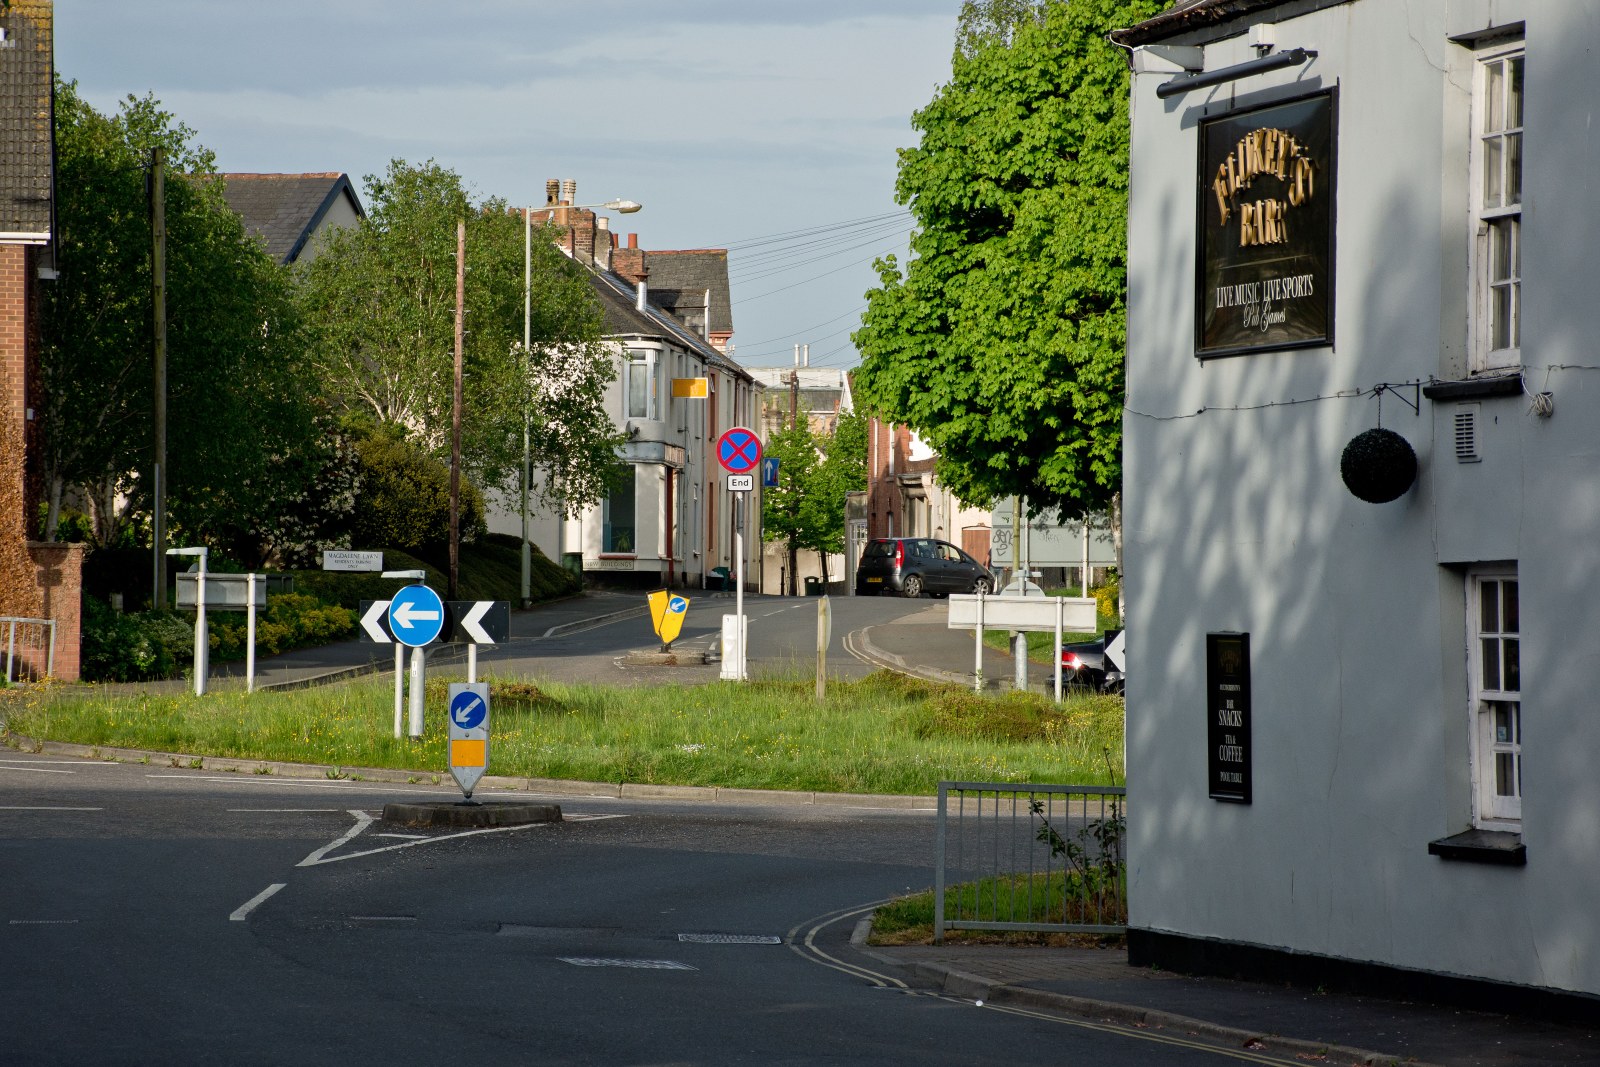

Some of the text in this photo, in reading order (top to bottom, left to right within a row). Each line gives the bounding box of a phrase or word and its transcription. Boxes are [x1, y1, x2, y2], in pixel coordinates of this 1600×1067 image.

[1239, 199, 1281, 247] BAR
[1216, 274, 1314, 308] LIVE MUSIC LIVE SPORTS
[1243, 297, 1286, 332] Pub Games
[1218, 709, 1243, 727] SNACKS
[1218, 744, 1243, 763] COFFEE
